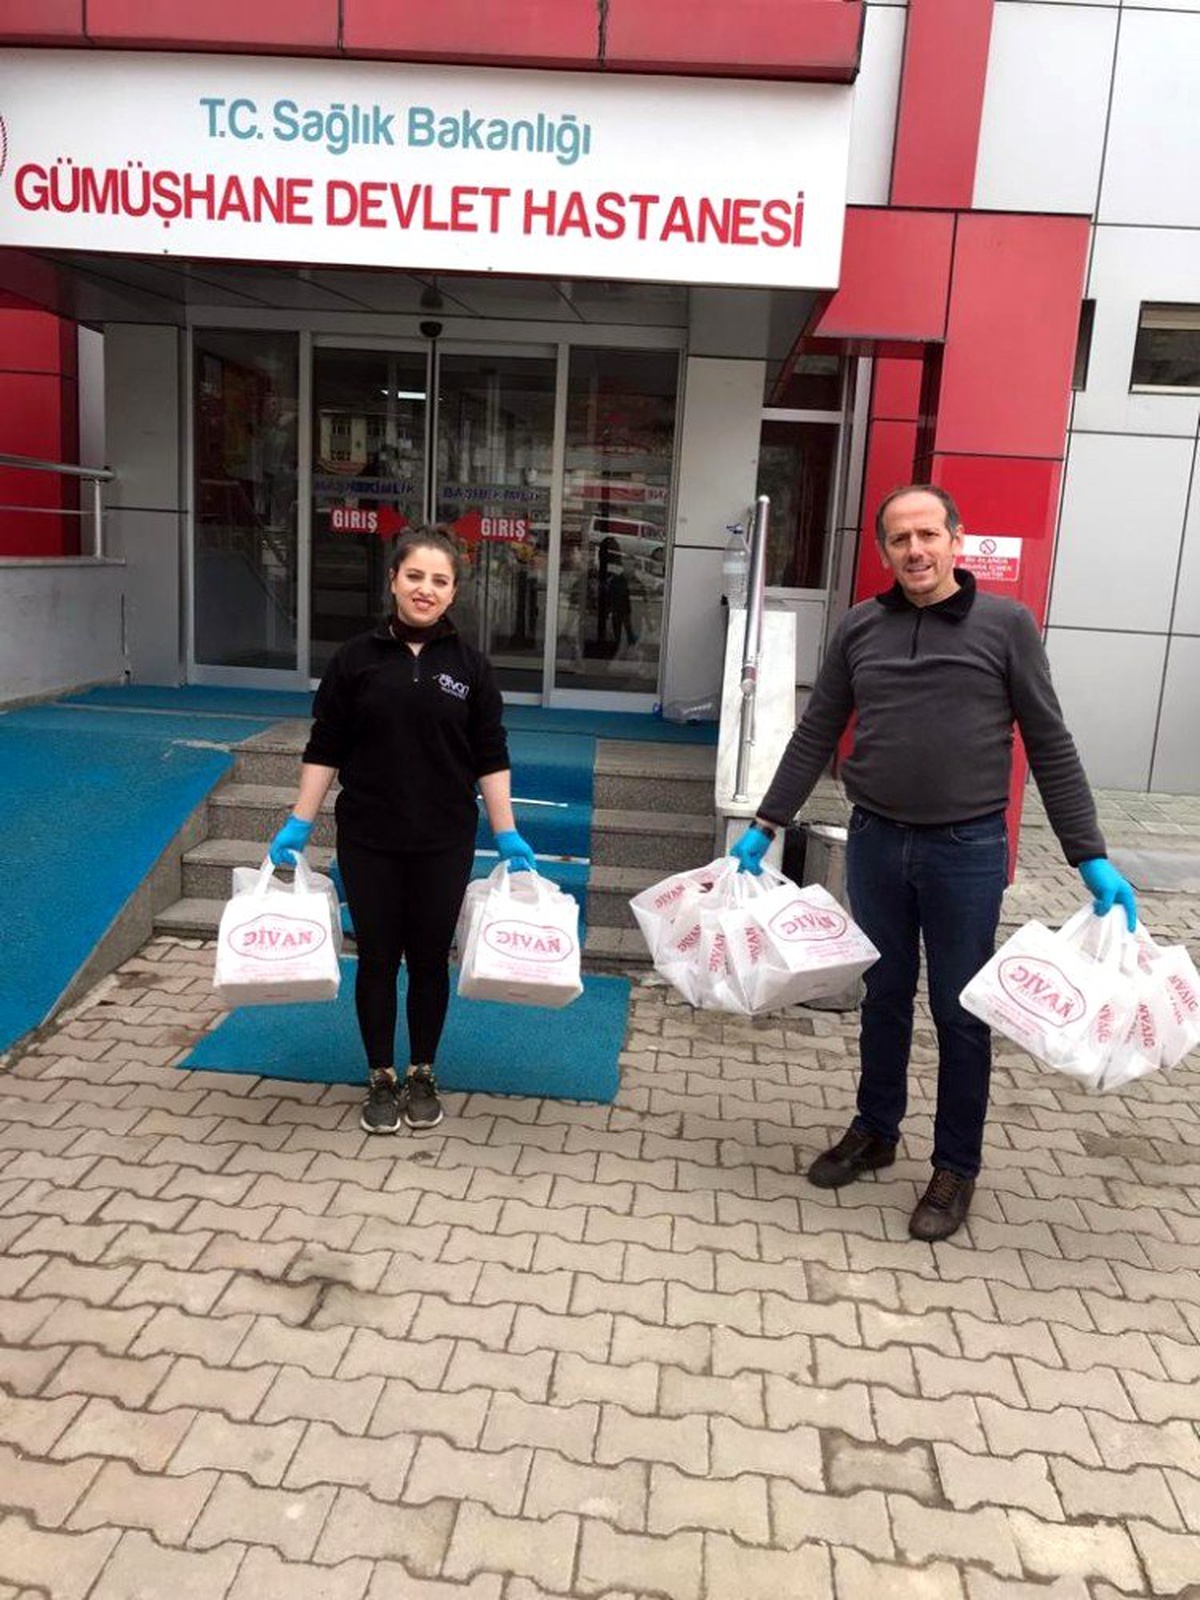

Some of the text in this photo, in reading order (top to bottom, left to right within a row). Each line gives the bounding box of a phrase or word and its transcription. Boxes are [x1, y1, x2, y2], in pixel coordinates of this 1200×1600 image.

[200, 99, 591, 165] T.C. Sağlık Bakanlığı
[15, 159, 805, 249] GÜMÜŞHANE DEVLET HASTANESİ
